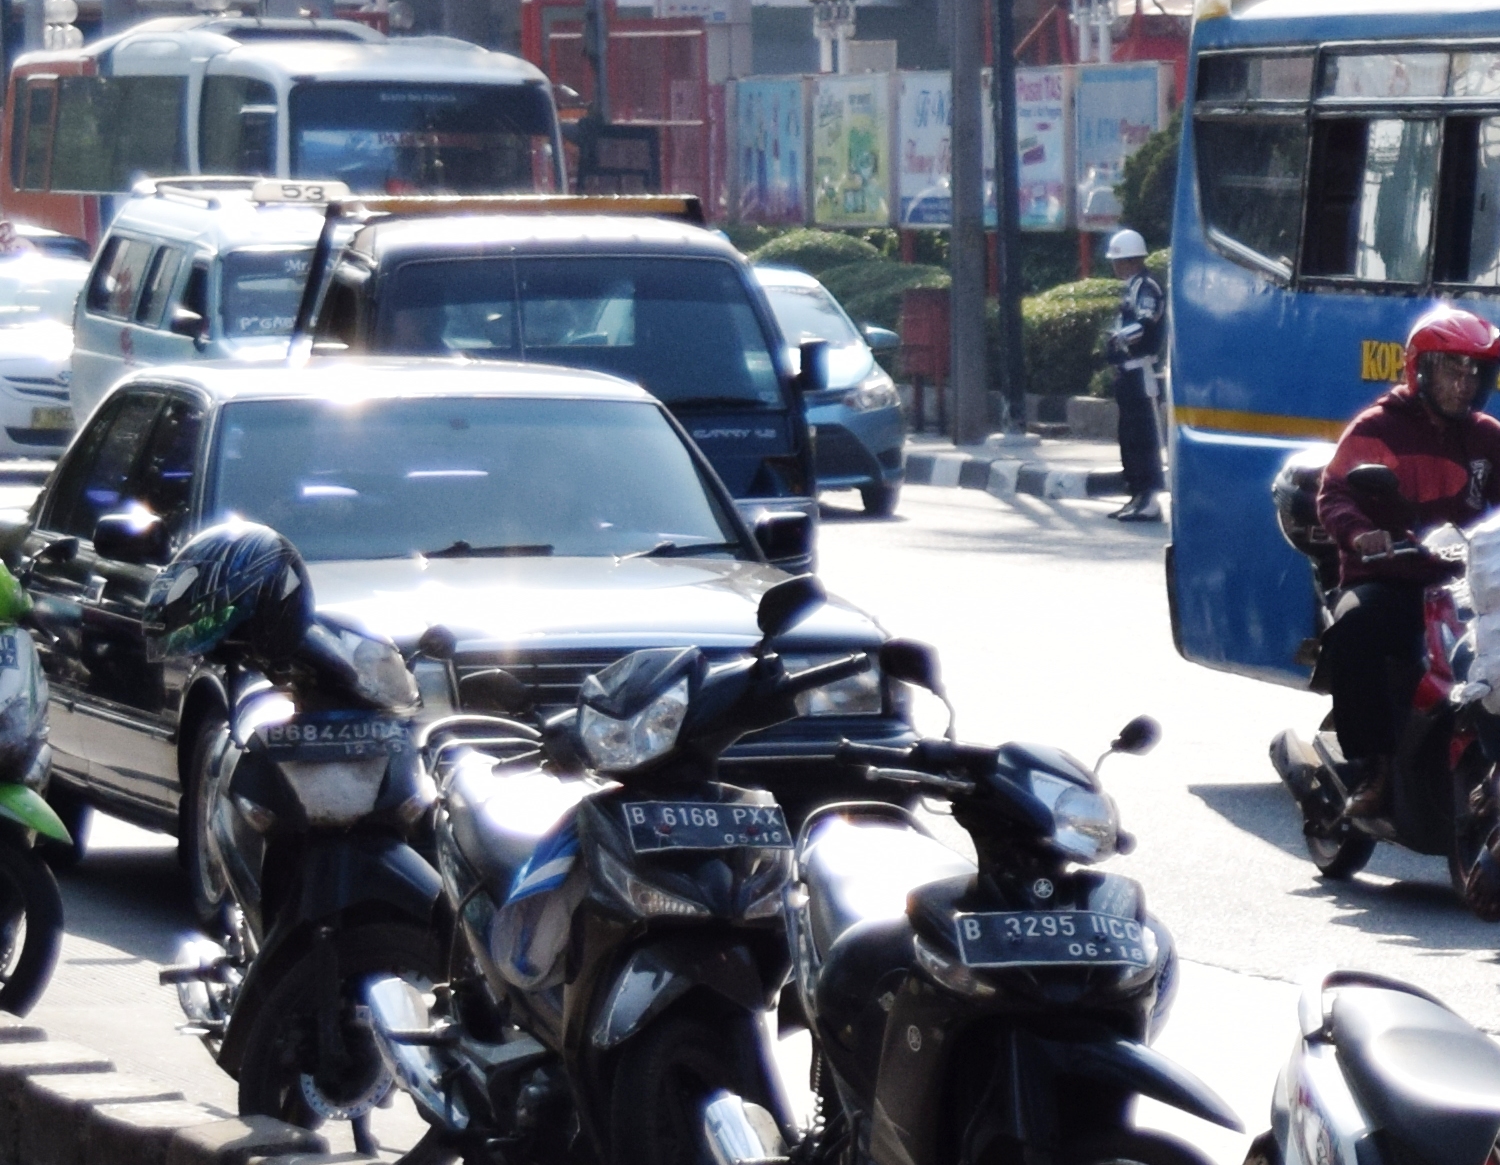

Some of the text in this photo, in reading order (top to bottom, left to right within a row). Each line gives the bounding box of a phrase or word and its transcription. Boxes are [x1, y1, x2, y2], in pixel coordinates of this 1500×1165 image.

[281, 185, 325, 201] 53
[1361, 340, 1408, 382] KOP
[631, 806, 781, 827] B 6168 PXX
[963, 919, 982, 940] B
[1004, 915, 1076, 937] 3295
